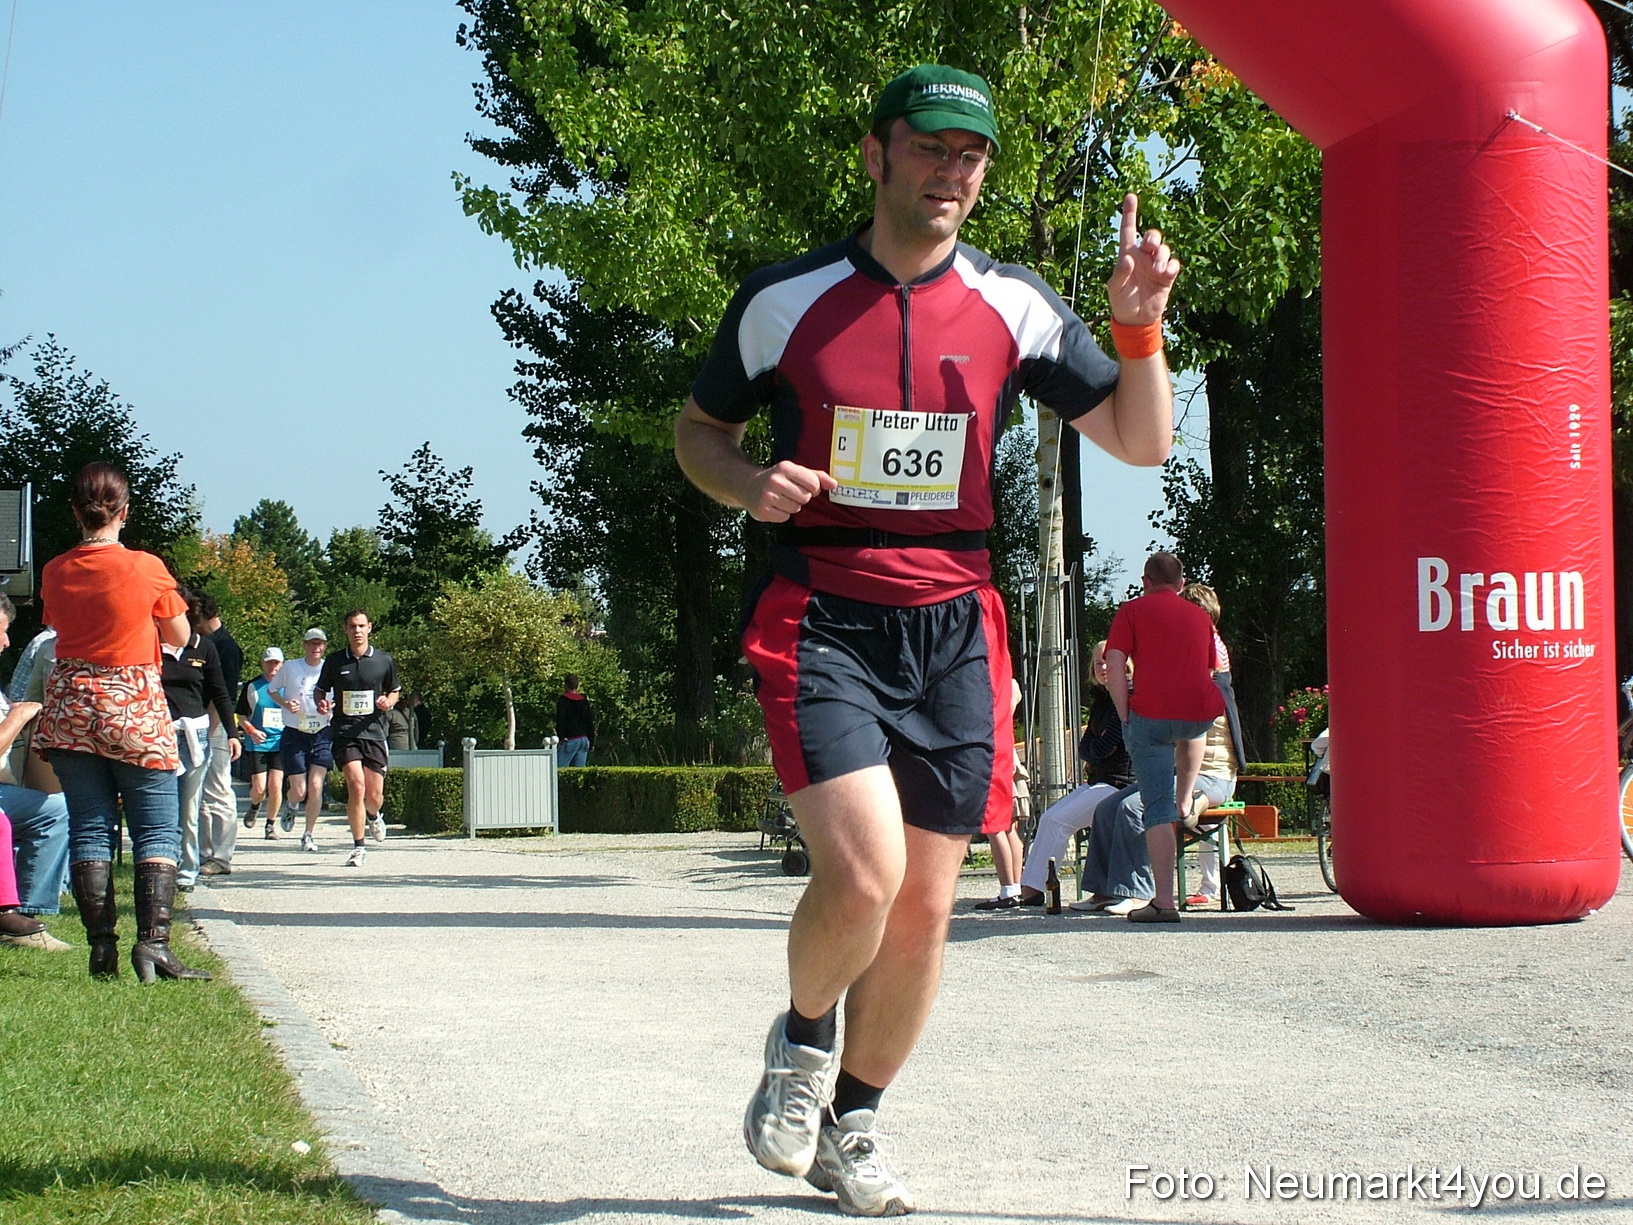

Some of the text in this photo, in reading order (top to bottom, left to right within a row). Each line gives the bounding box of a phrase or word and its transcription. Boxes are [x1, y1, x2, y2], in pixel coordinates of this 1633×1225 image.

[871, 410, 919, 431] Peter
[1568, 403, 1580, 437] 1929
[838, 436, 847, 451] C
[882, 448, 944, 478] 636
[910, 491, 955, 501] PFLEIDERER
[1417, 557, 1585, 632] Braun
[1492, 637, 1595, 659] Sicher ist sicher
[354, 701, 369, 709] 871
[308, 720, 321, 728] 379
